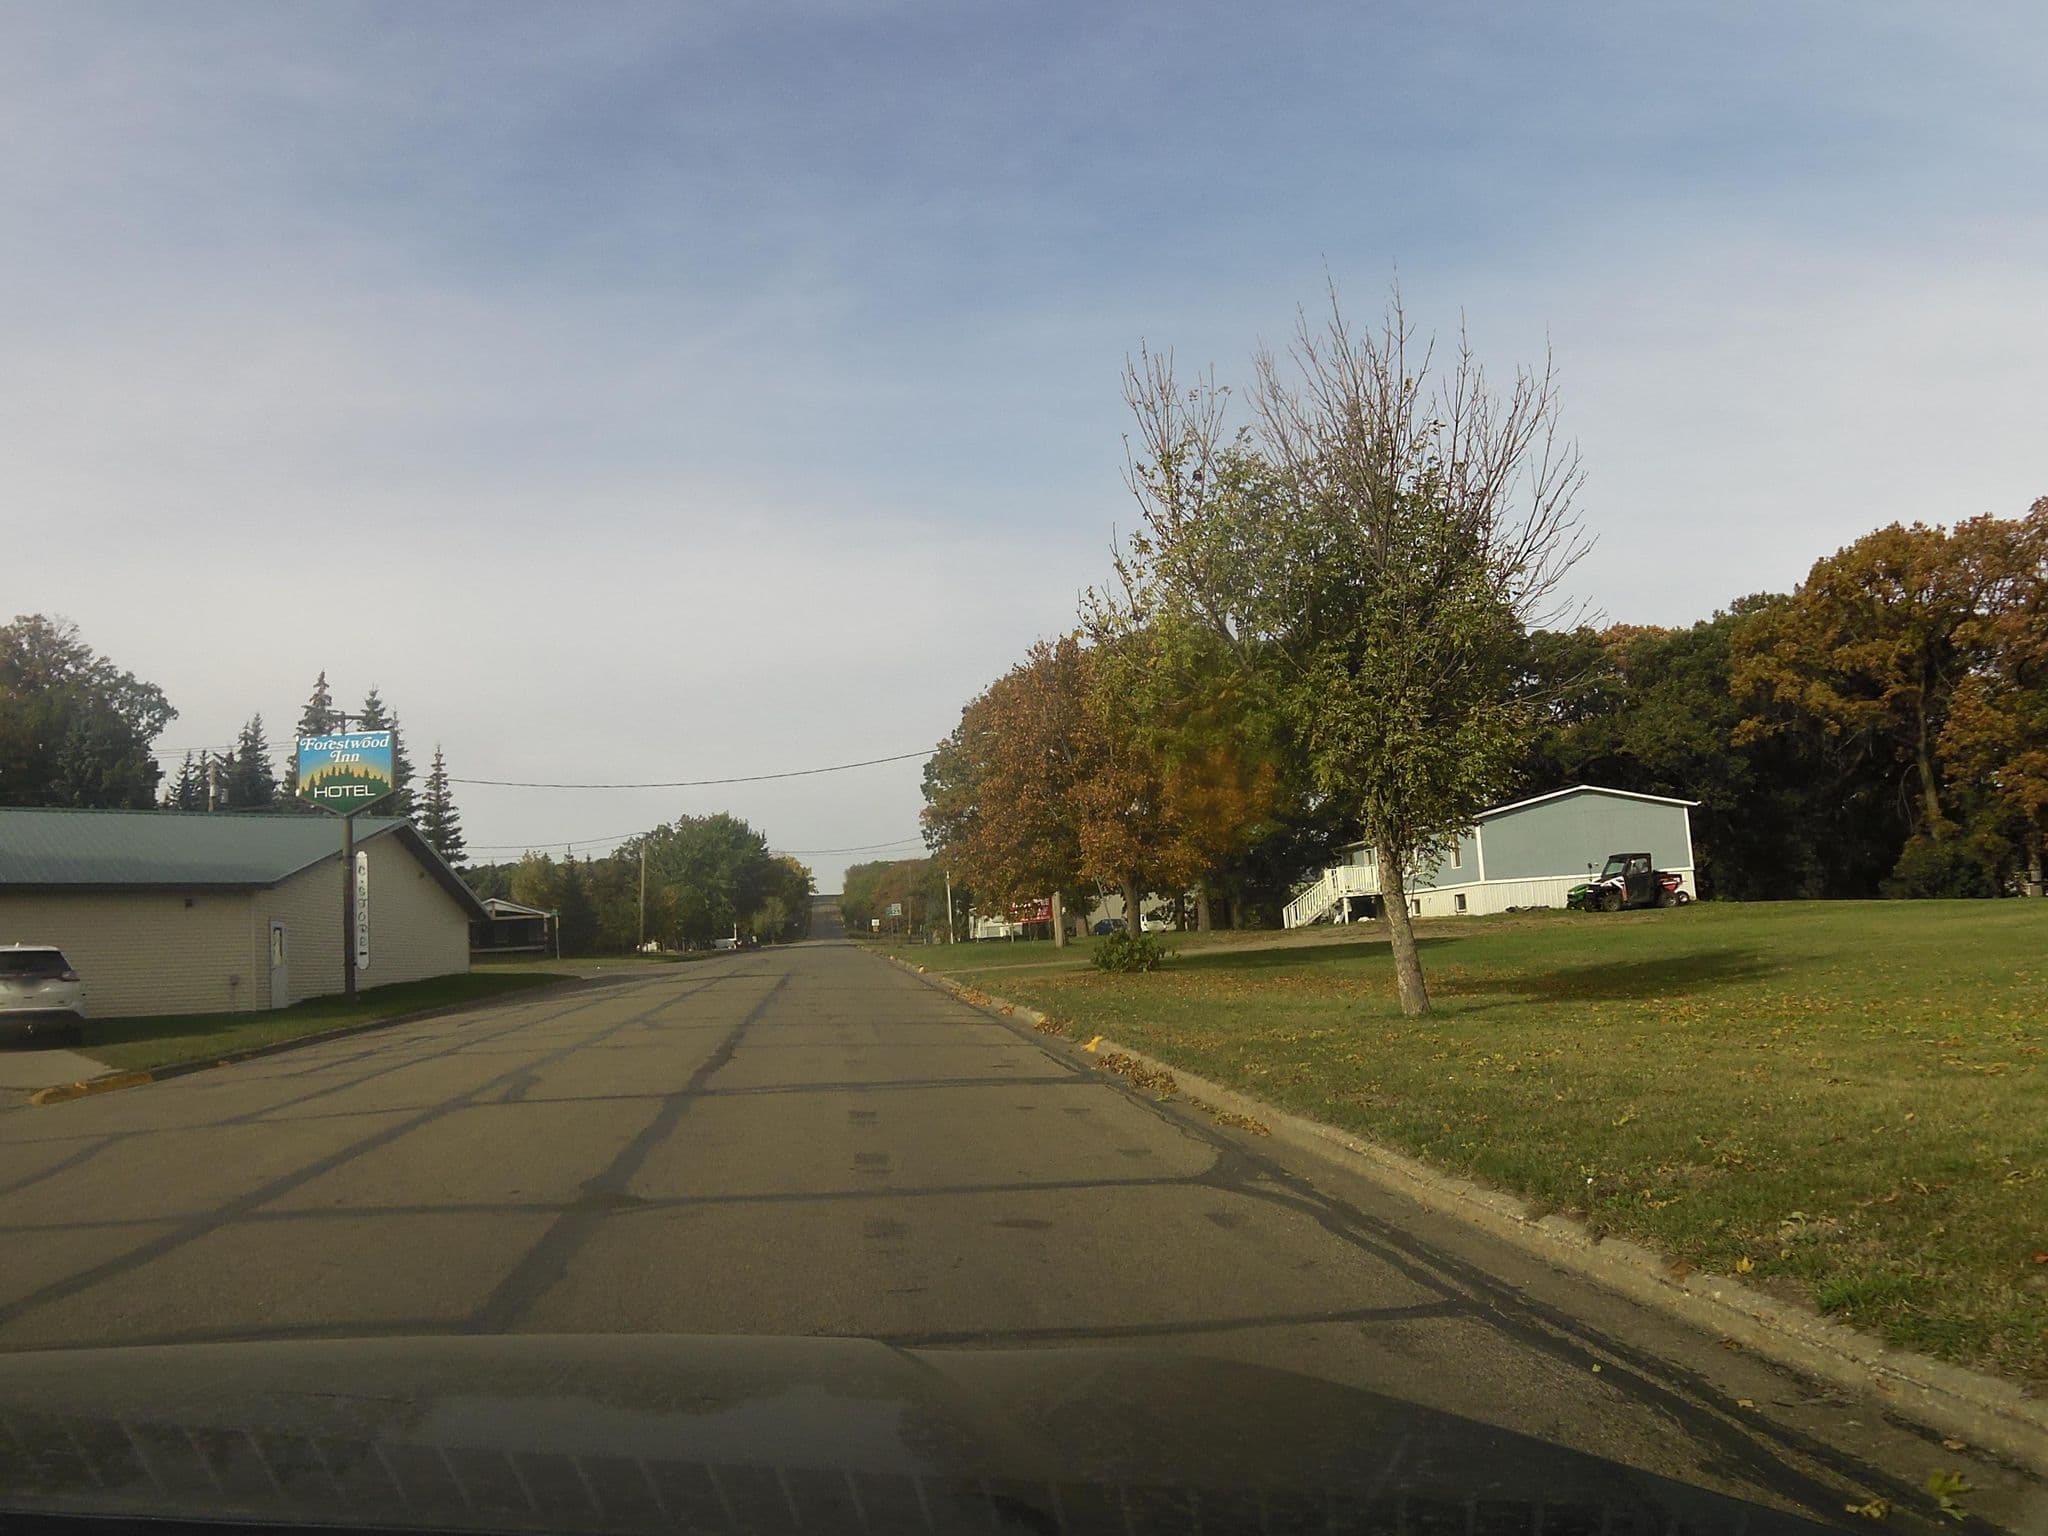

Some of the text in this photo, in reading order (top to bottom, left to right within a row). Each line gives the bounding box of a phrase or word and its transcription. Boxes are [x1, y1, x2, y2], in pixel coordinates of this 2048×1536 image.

[299, 734, 390, 751] Forestwood
[330, 750, 360, 763] Inn
[314, 785, 376, 798] HOTEL
